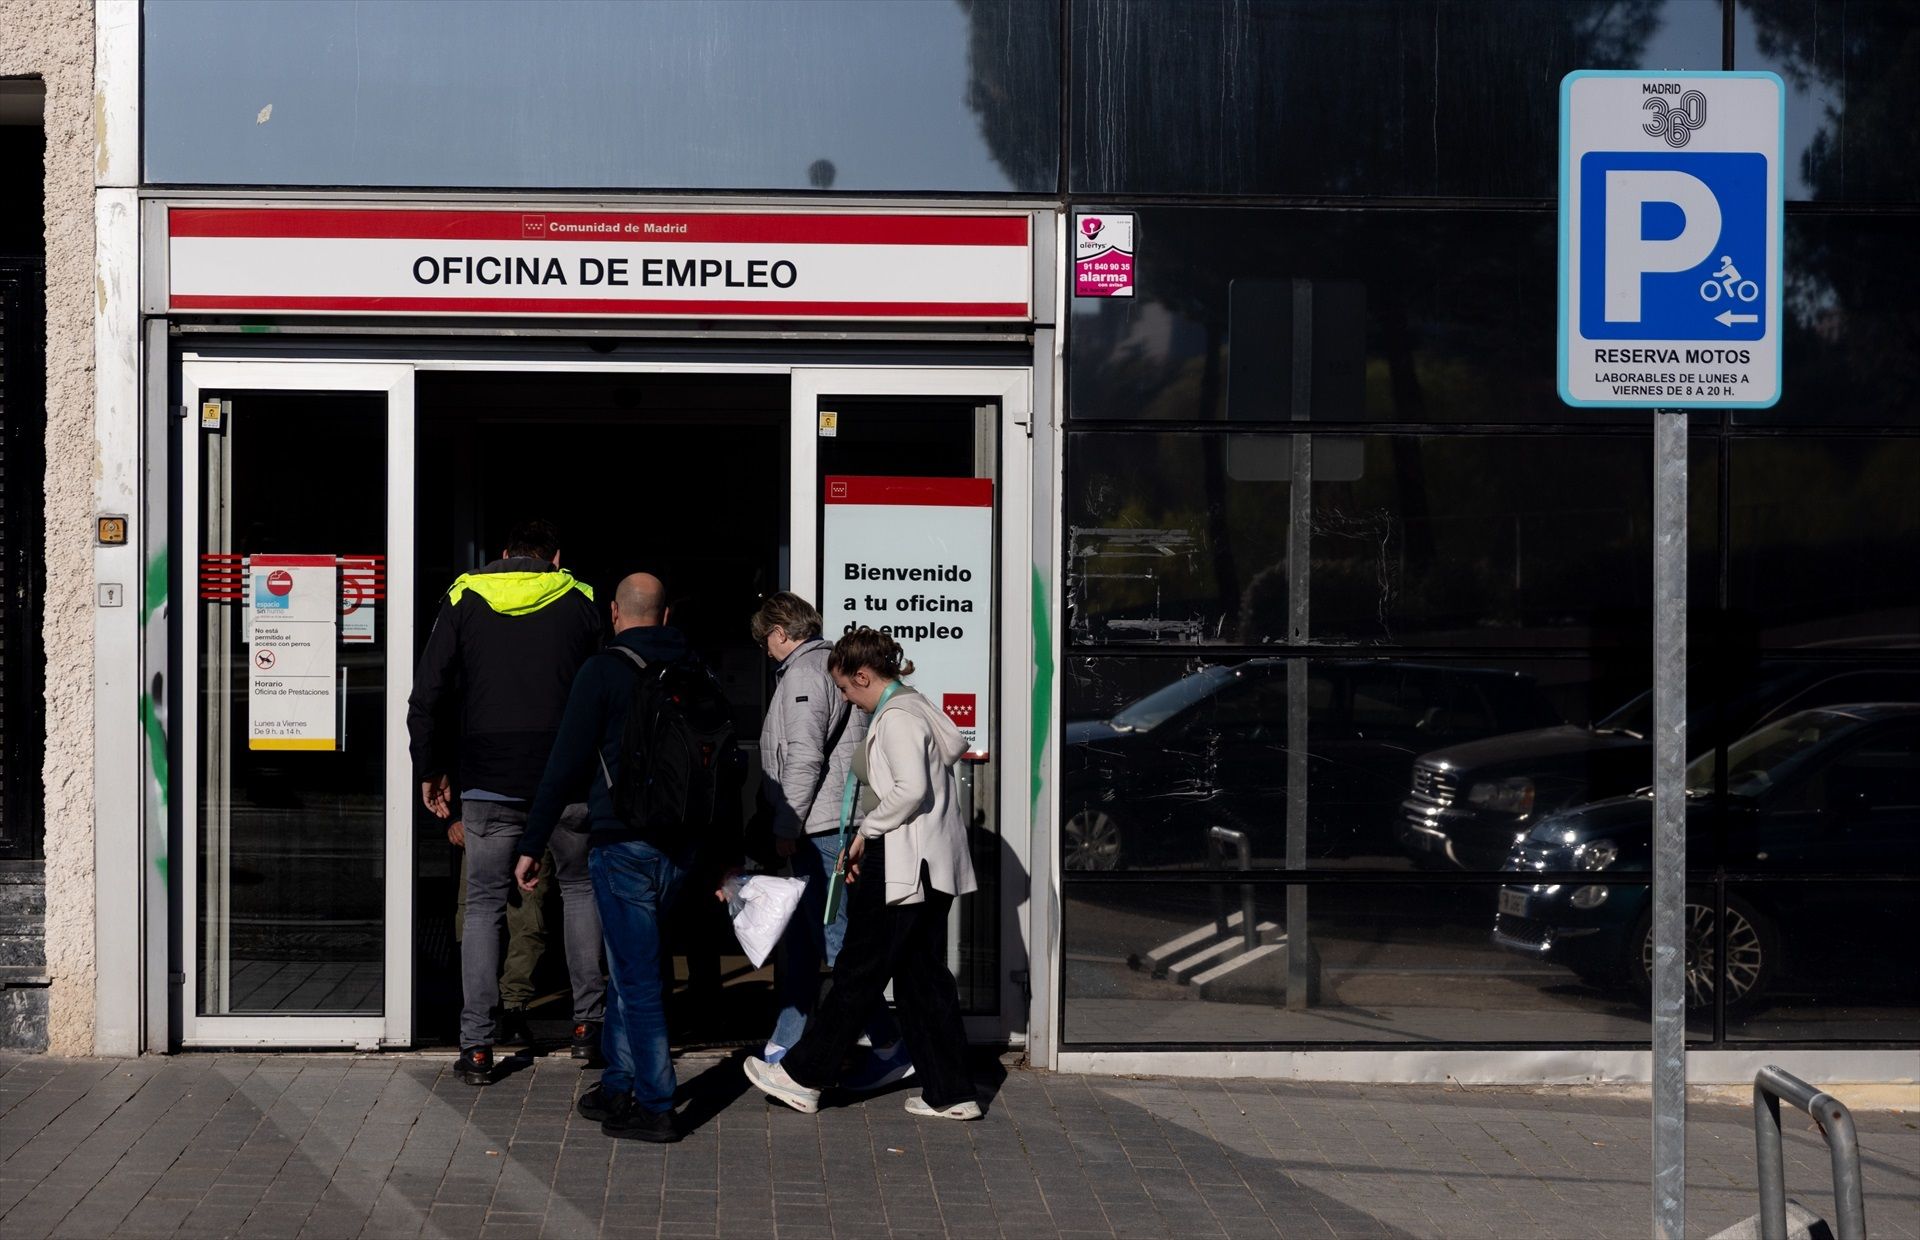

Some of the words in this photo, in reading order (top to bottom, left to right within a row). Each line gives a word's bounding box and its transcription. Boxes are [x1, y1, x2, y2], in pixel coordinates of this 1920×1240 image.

[1642, 83, 1681, 95] MADRID
[1642, 89, 1707, 149] 360
[549, 220, 622, 235] Comunidad
[624, 221, 640, 235] de
[643, 221, 688, 236] Madrid
[1604, 169, 1722, 323] P
[412, 255, 568, 286] OFICINA
[578, 258, 631, 286] DE
[642, 258, 799, 288] EMPLEO
[1080, 272, 1127, 282] alarma
[1595, 349, 1680, 364] RESERVA
[1686, 350, 1751, 364] MOTOS
[1595, 373, 1676, 384] LABORABLES
[1679, 373, 1696, 384] DE
[1698, 373, 1738, 384] LUNES
[1741, 374, 1750, 384] A
[1612, 385, 1664, 396] VIERNES
[1667, 385, 1684, 396] DE
[1686, 385, 1693, 396] 8
[1695, 385, 1705, 396] A
[1707, 386, 1721, 396] 20
[1723, 386, 1735, 396] H.
[844, 562, 972, 582] Bienvenido
[843, 598, 857, 611] a
[865, 595, 888, 611] tu
[895, 594, 974, 613] oficina
[879, 622, 964, 642] empleo
[288, 688, 330, 696] Prestaciones
